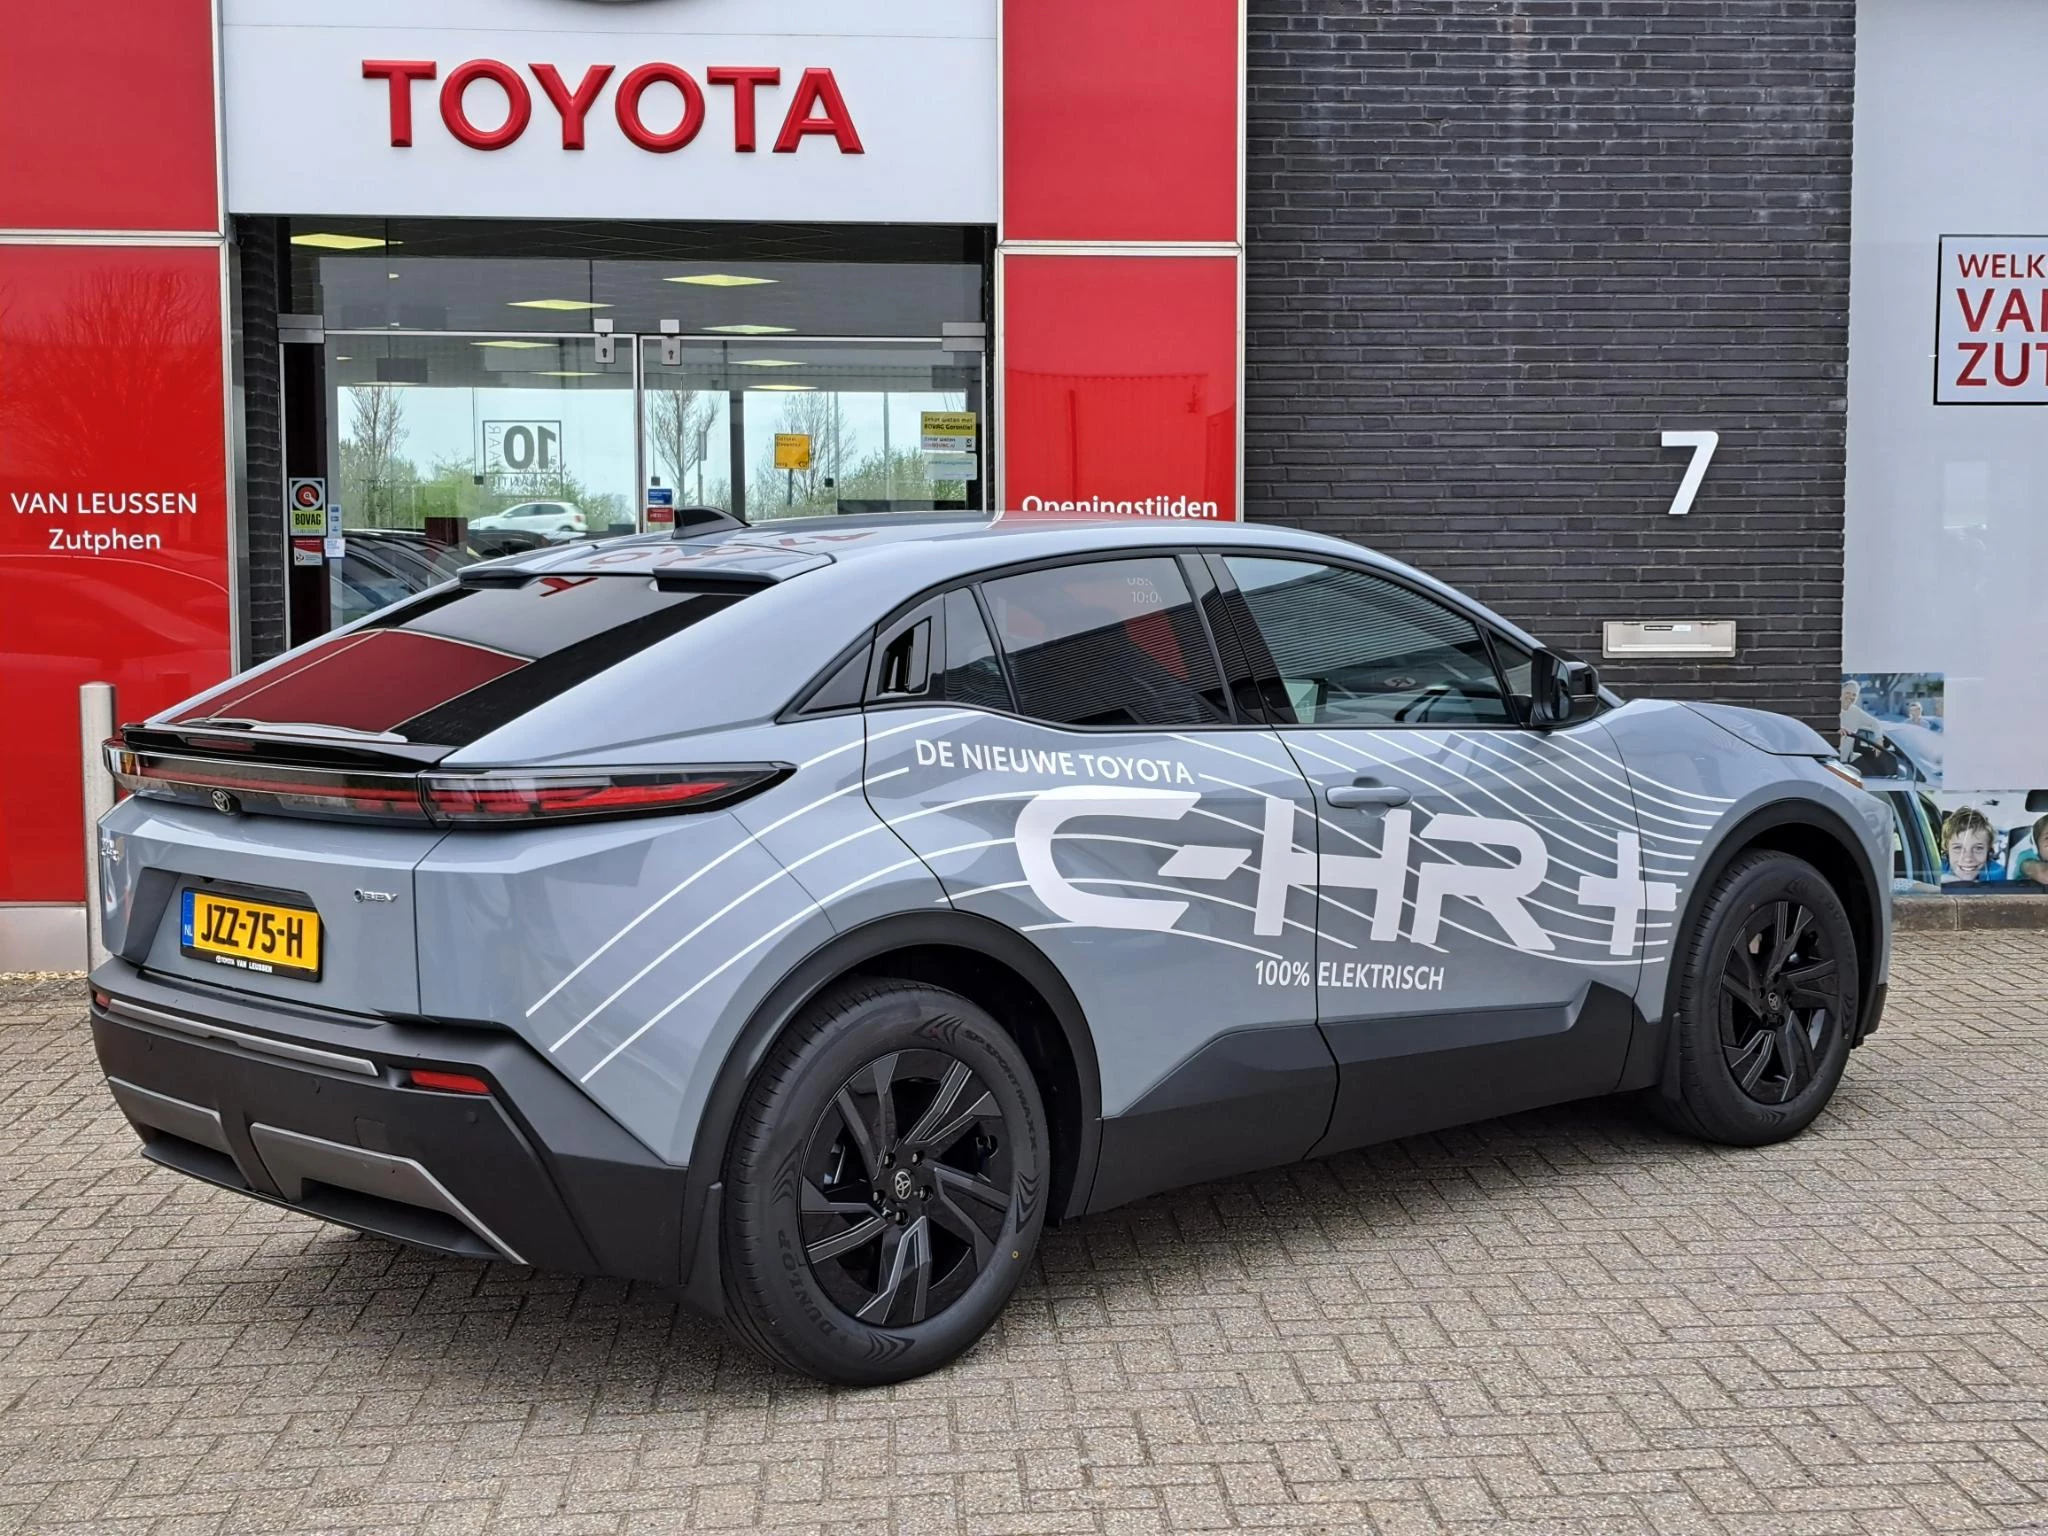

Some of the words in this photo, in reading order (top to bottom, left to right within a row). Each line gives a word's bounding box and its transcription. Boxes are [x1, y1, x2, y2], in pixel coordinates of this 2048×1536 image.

[362, 58, 865, 154] TOYOTA
[1956, 288, 2048, 333] VA
[1661, 431, 1719, 514] 7
[10, 492, 68, 514] VAN
[77, 492, 197, 514] LEUSSEN
[295, 513, 322, 526] BOVAG
[48, 528, 161, 555] Zutphen
[915, 739, 954, 767] DE
[961, 743, 1077, 776] NIEUWE
[1079, 754, 1196, 785] TOYOTA
[184, 924, 193, 937] NL
[201, 903, 304, 959] JZZ-75-H
[236, 959, 248, 969] VAN
[1255, 960, 1310, 987] 100%
[1317, 962, 1445, 991] ELEKTRISCH
